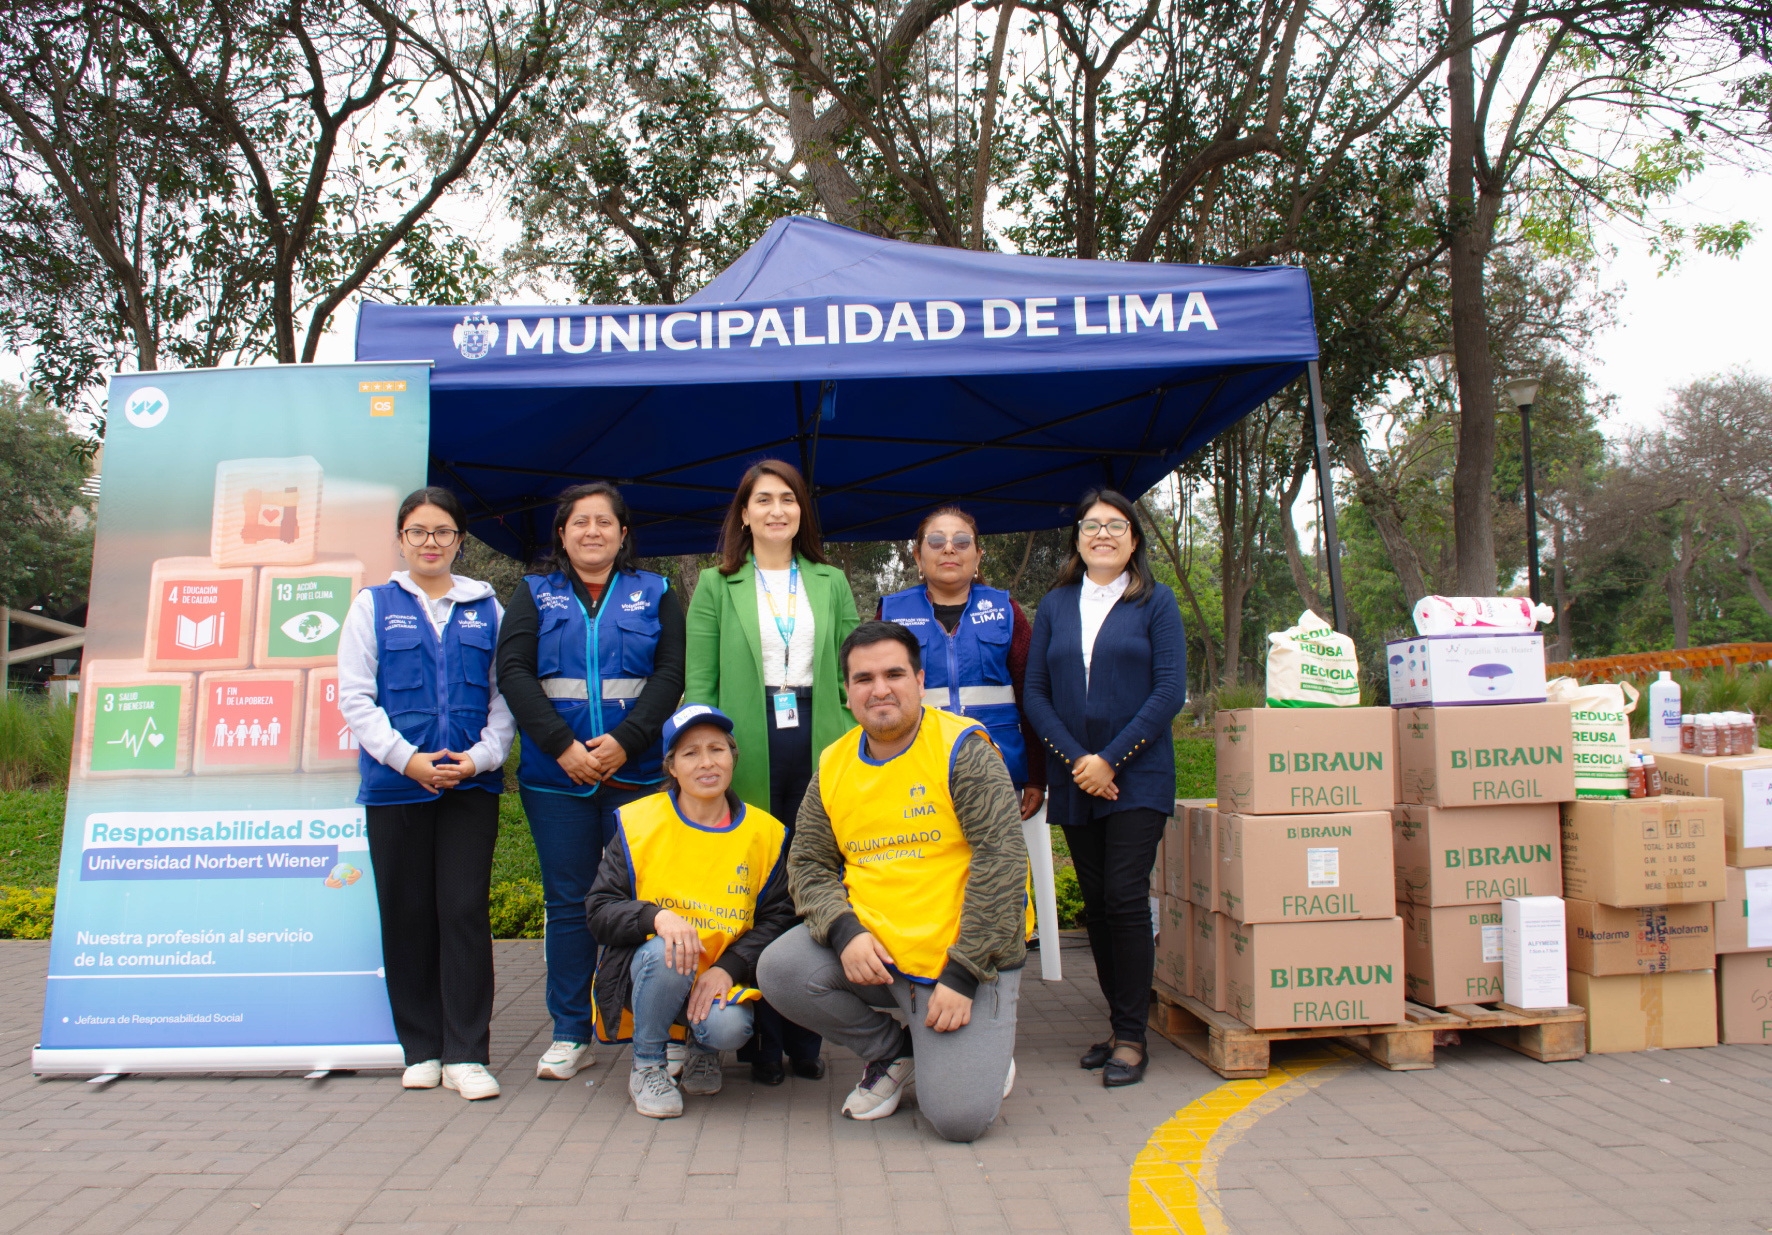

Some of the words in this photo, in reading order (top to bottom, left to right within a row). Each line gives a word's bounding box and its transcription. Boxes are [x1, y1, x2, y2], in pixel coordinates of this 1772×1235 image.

[506, 300, 967, 356] MUNICIPALIDAD
[982, 297, 1060, 339] DE
[1074, 291, 1219, 336] LIMA
[374, 401, 392, 412] QS
[182, 585, 218, 595] EDUCACIÓN
[276, 583, 293, 601] 13
[296, 581, 318, 591] ACCIÓN
[168, 586, 178, 604] 4
[182, 595, 192, 604] DE
[191, 595, 218, 604] CALIDAD
[296, 592, 307, 601] POR
[308, 591, 314, 600] EL
[314, 590, 333, 599] CLIMA
[971, 612, 1005, 625] LIMA
[1300, 643, 1343, 657] REUSA
[1464, 648, 1491, 656] Paraffin
[1300, 663, 1355, 680] RECICLA
[119, 692, 138, 701] SALUD
[216, 687, 223, 705] 1
[227, 687, 238, 696] FIN
[326, 684, 335, 702] 8
[104, 693, 114, 712] 3
[118, 703, 123, 711] Y
[123, 701, 155, 711] BIENESTAR
[226, 697, 236, 706] DE
[236, 697, 244, 705] LA
[244, 696, 274, 705] POBREZA
[1571, 711, 1623, 721] REDUCE
[1572, 731, 1616, 742] REUSA
[1573, 753, 1623, 764] RECICLA
[1291, 785, 1362, 806] FRAGIL
[1473, 779, 1543, 801] FRAGIL
[904, 805, 937, 818] LIMA
[91, 820, 303, 846] Responsabilidad
[1562, 831, 1579, 841] GASA
[844, 829, 941, 853] VOLUNTARIADO
[88, 854, 192, 872] Universidad
[195, 853, 263, 869] Norbert
[266, 851, 330, 869] Wiener
[858, 848, 926, 865] MUNICIPAL
[1466, 877, 1533, 900] FRAGIL
[1697, 880, 1708, 888] CM
[655, 897, 750, 922] VOLUNTARIADO
[1283, 893, 1360, 916] FRAGIL
[1585, 930, 1630, 941] Alkofarma
[1664, 924, 1709, 935] Alkofarma
[76, 930, 143, 946] Nuestra
[146, 929, 226, 949] profesión
[229, 929, 244, 944] al
[247, 927, 314, 944] servicio
[74, 952, 95, 967] de
[99, 952, 114, 966] la
[117, 950, 217, 967] comunidad.
[1293, 1000, 1370, 1022] FRAGIL
[74, 1014, 116, 1026] Jefatura
[117, 1014, 130, 1025] de
[132, 1013, 212, 1026] Responsabilidad
[213, 1013, 243, 1023] Social
